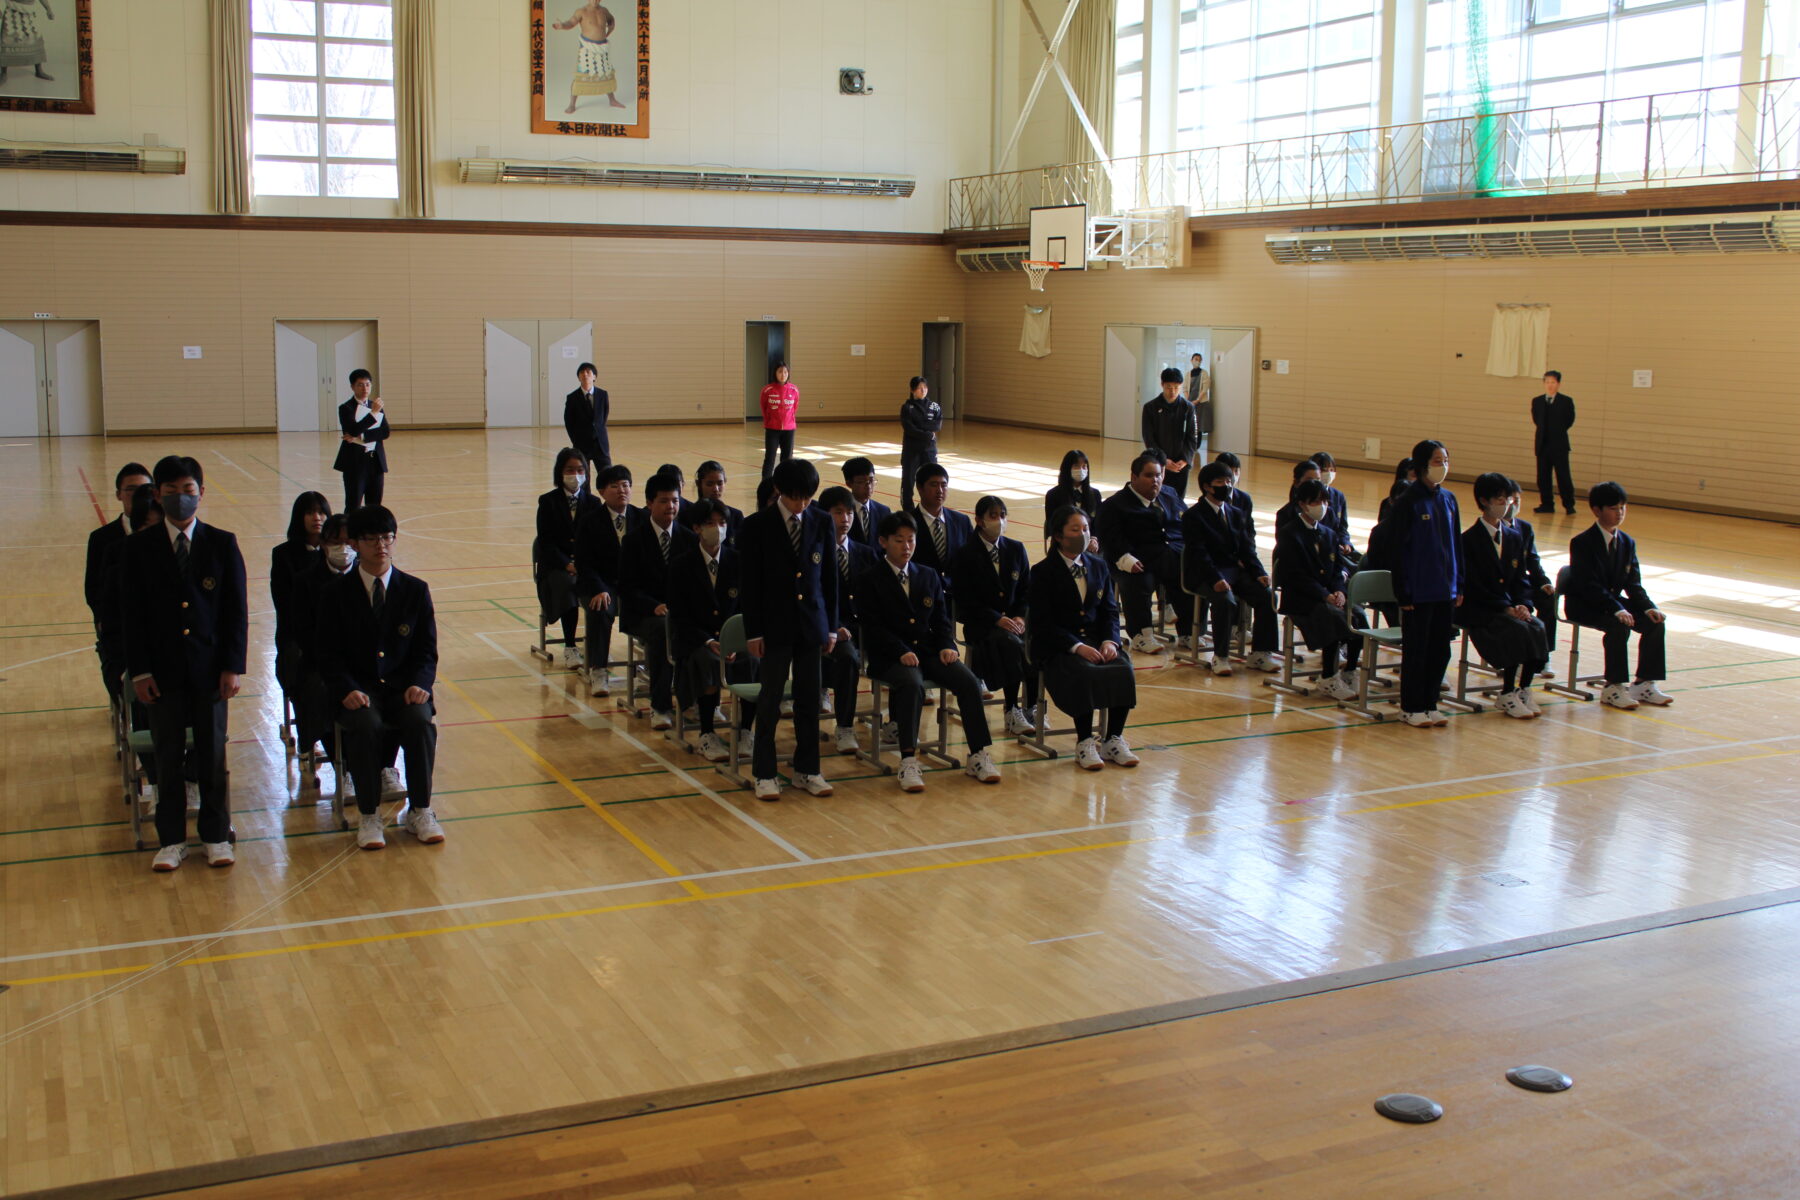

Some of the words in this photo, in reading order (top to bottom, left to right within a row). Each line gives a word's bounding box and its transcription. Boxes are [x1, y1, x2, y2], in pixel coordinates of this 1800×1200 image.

[556, 121, 628, 137] 毎日新聞社
